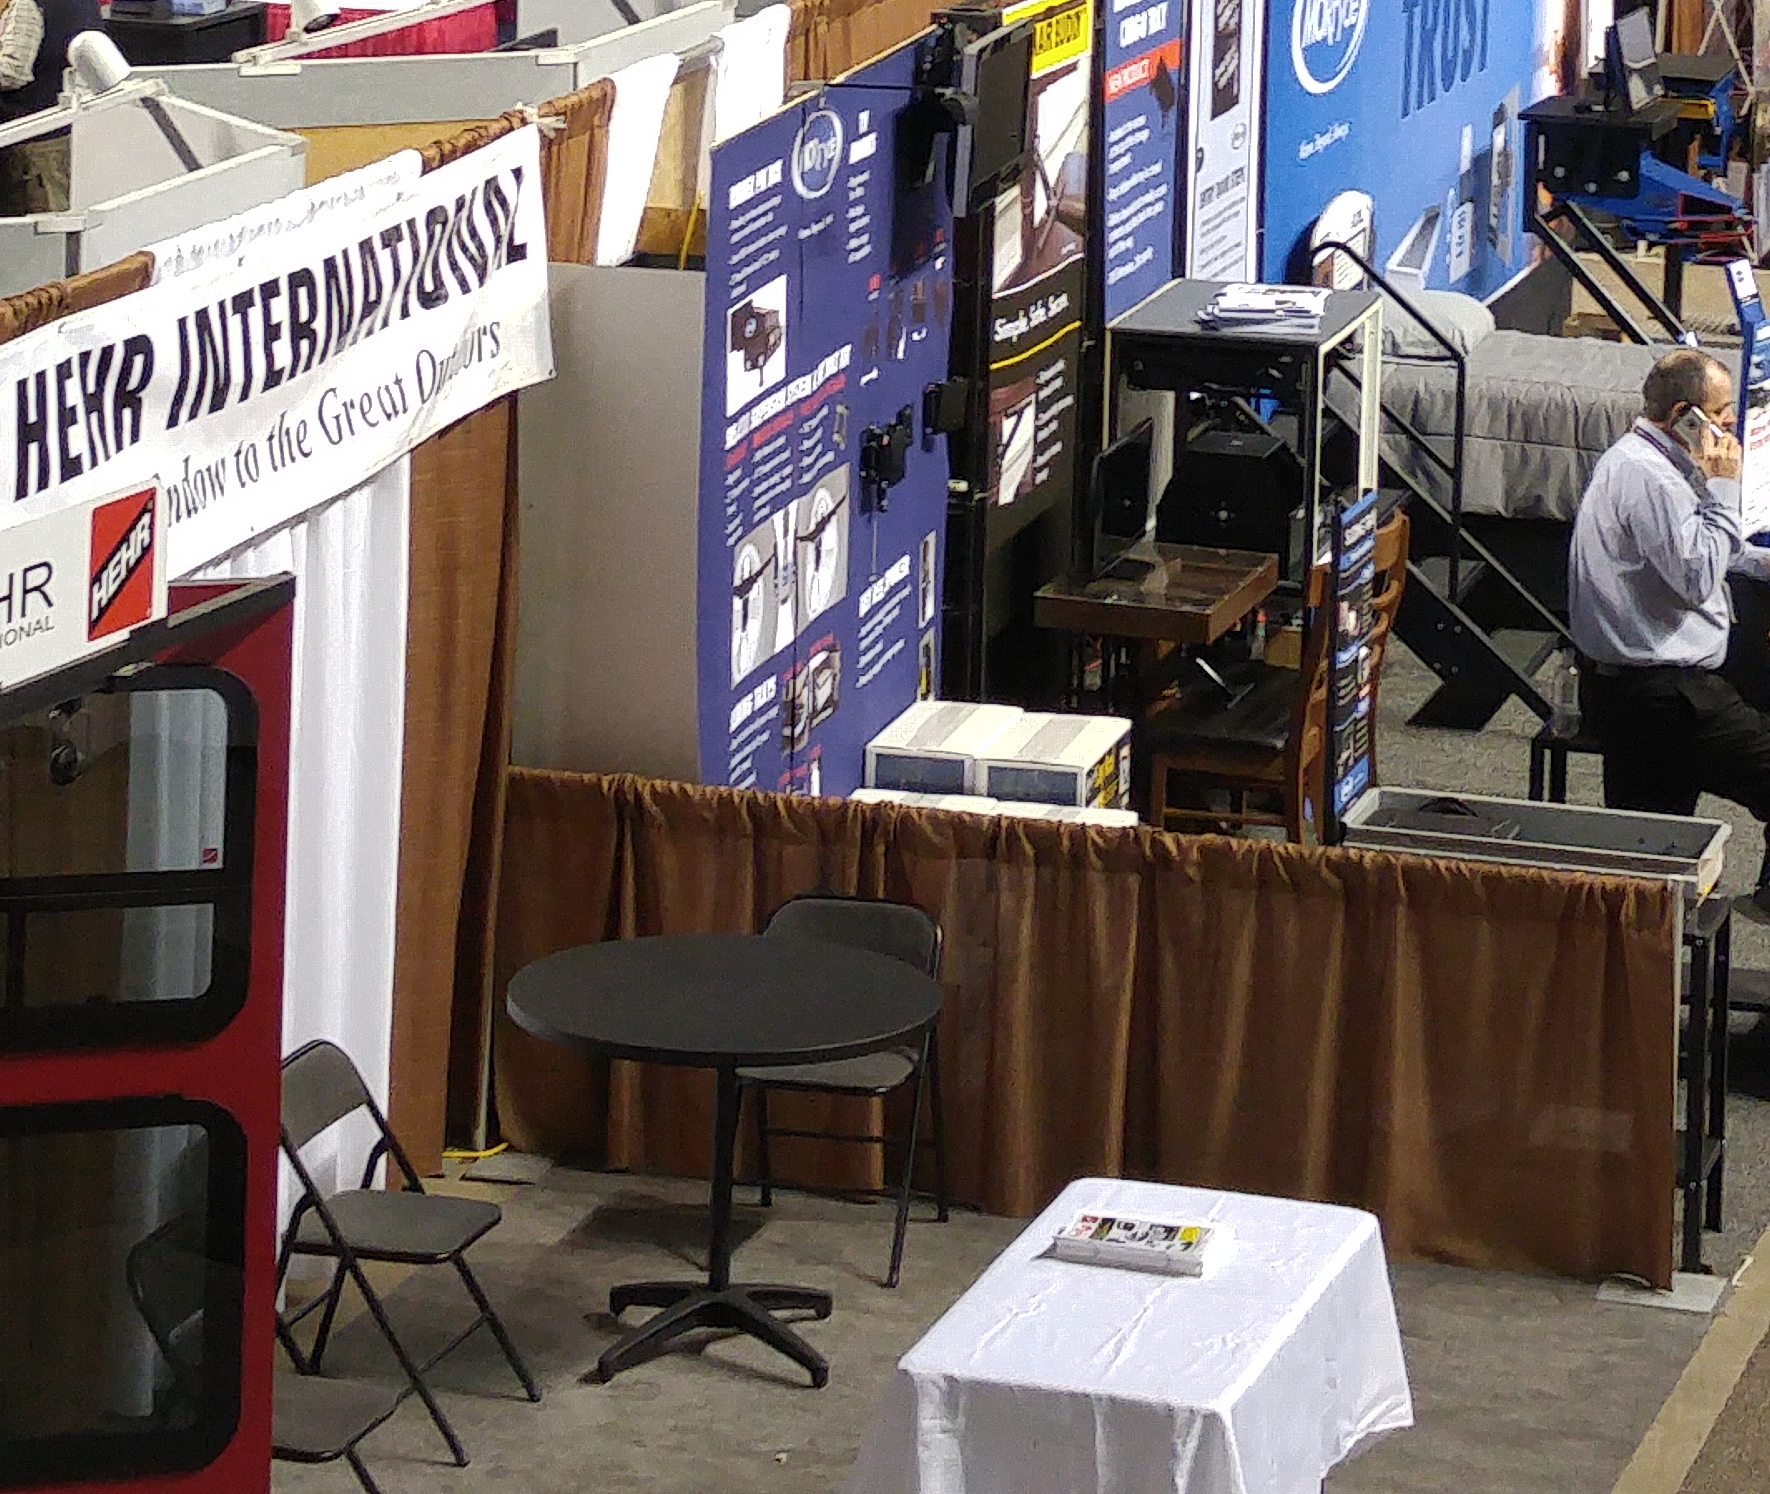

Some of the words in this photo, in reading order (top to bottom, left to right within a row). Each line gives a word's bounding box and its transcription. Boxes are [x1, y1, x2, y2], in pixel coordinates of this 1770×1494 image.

[14, 332, 155, 505] HEHR
[166, 166, 528, 431] INTERNATIONAL
[234, 438, 260, 490] to
[265, 409, 314, 474] the
[317, 366, 410, 448] Great
[90, 506, 153, 622] HEHR
